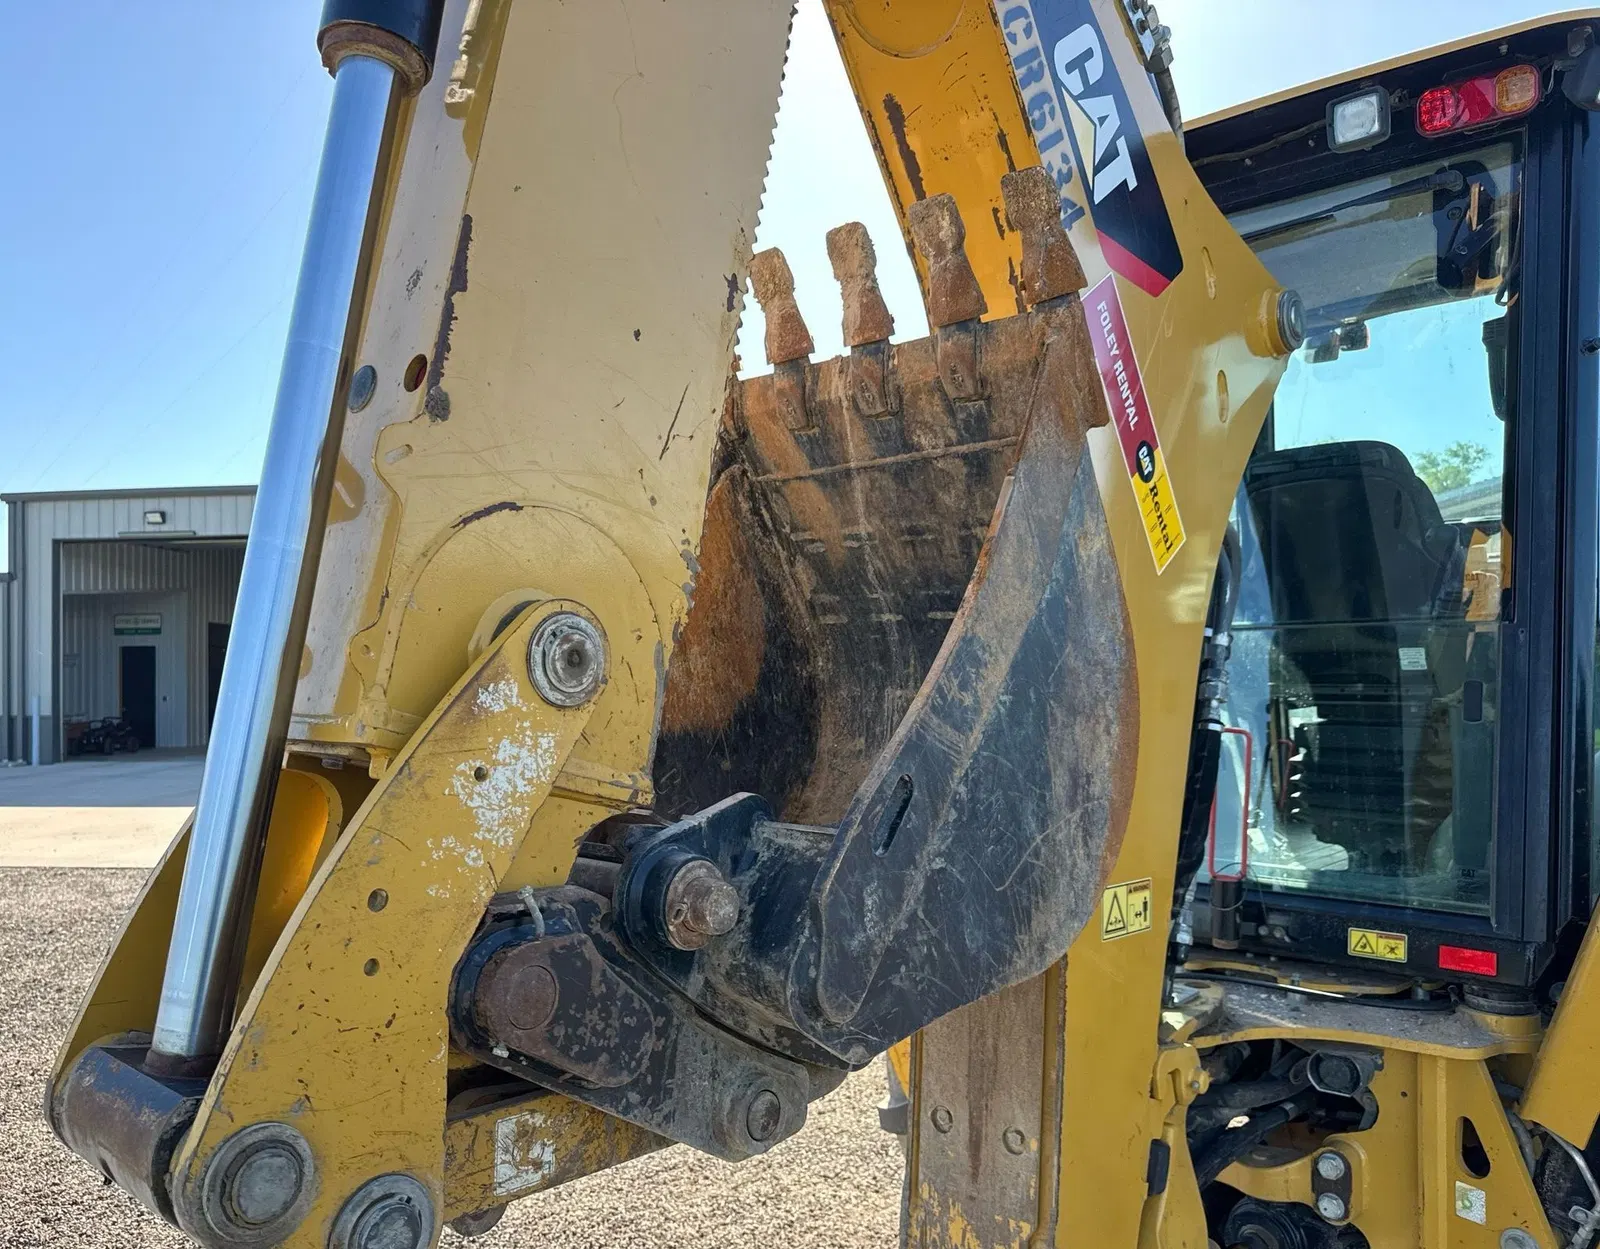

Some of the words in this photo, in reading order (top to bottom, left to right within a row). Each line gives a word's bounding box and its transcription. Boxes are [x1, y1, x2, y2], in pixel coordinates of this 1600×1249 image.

[998, 0, 1086, 232] CR6134
[1054, 23, 1138, 205] CAT
[1097, 300, 1120, 357] FOLEY
[1113, 359, 1139, 432] RENTAL
[1138, 446, 1153, 476] CAT
[1149, 482, 1175, 553] Rental
[1461, 868, 1476, 878] CAT
